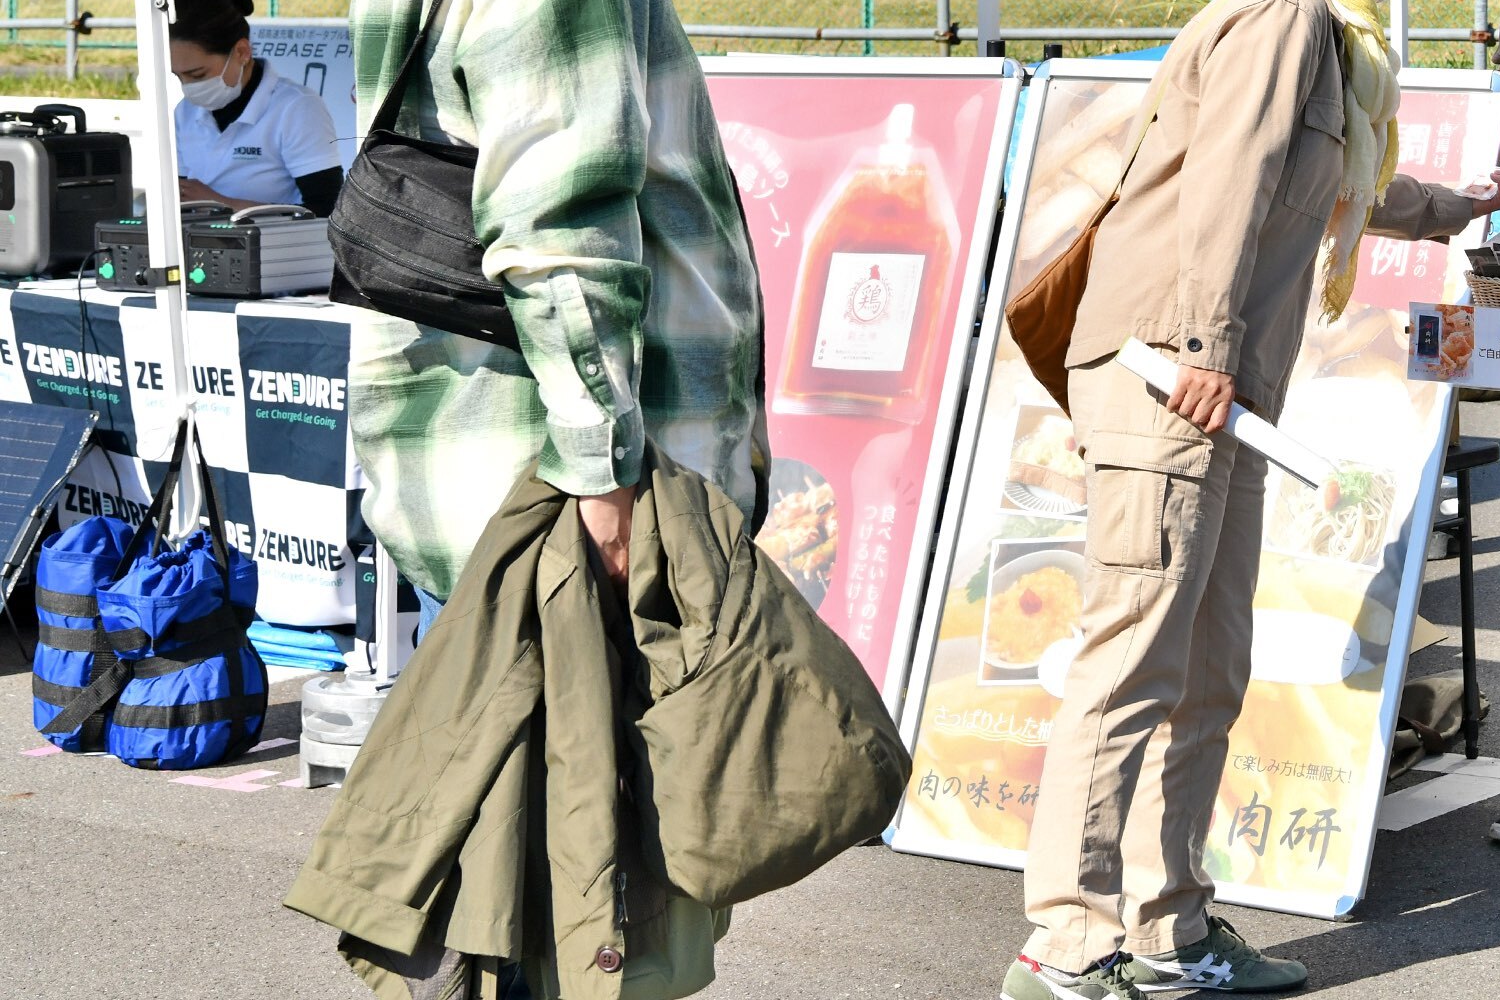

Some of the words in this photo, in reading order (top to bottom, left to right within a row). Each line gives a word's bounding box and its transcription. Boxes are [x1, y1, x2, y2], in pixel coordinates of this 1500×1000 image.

[21, 341, 123, 388] ZENDURE
[248, 368, 347, 411] ZENDURE
[255, 408, 269, 419] Get
[257, 528, 346, 572] ZENDURE
[846, 505, 878, 620] つけるだけ!
[857, 504, 897, 641] 食べたいものに
[1231, 753, 1353, 784] で楽しみ方は無限大!
[1227, 789, 1342, 873] 肉研
